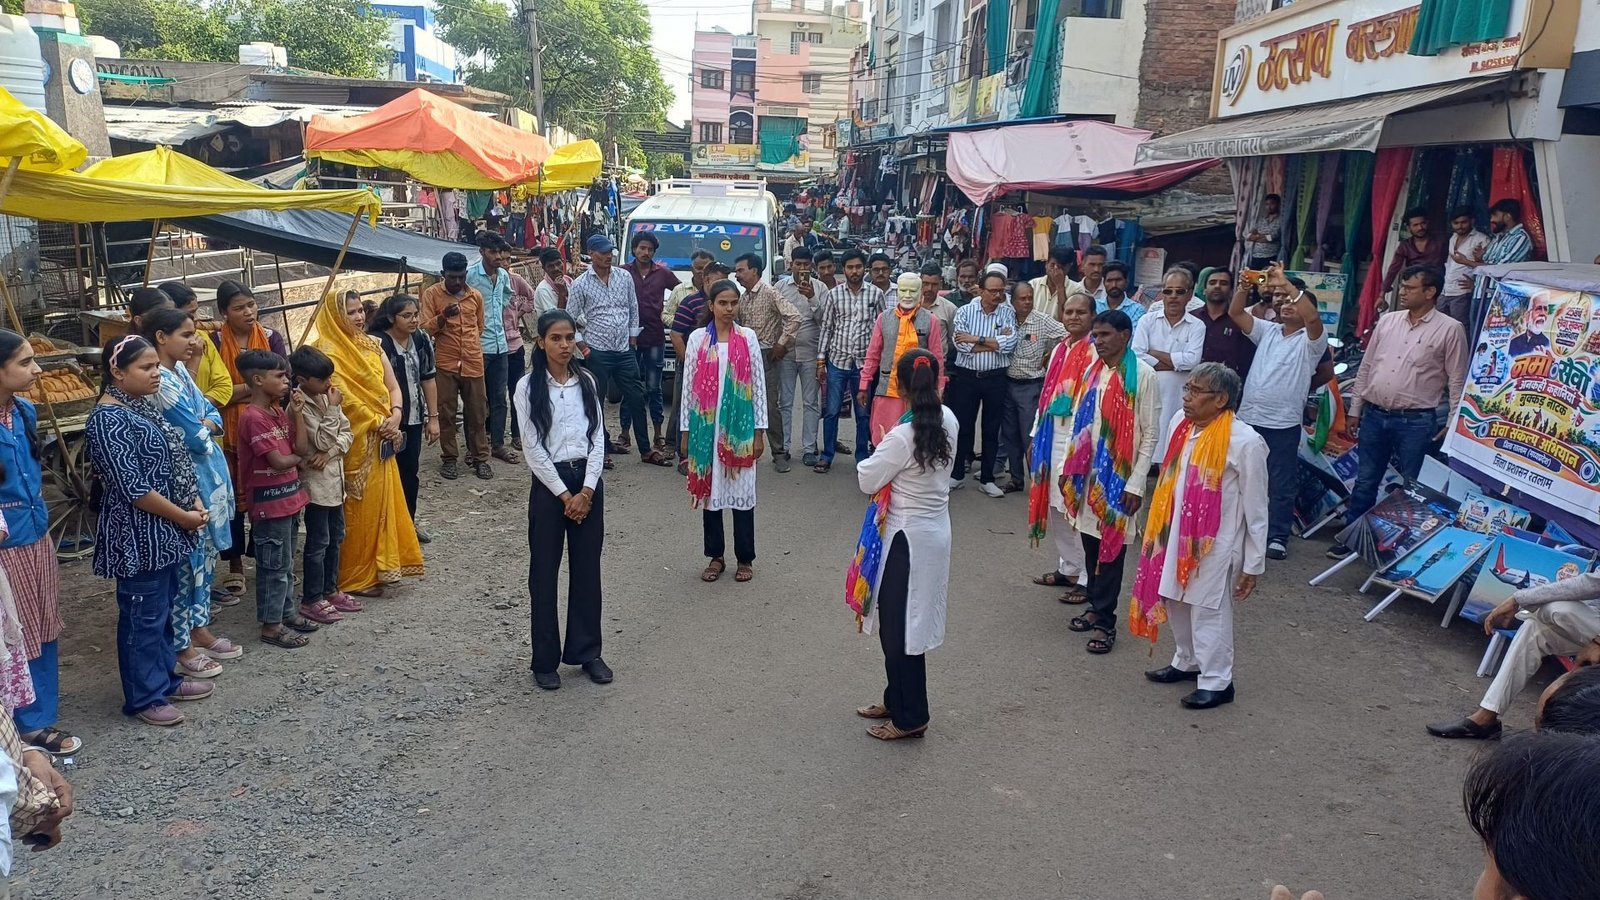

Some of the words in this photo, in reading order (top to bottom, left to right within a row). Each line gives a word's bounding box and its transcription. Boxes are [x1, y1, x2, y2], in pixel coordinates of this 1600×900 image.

[1257, 19, 1340, 91] उत्सव
[1346, 8, 1420, 62] वस्त्रा
[1192, 141, 1215, 158] उत्सव
[1217, 137, 1262, 156] वस्त्रालय
[635, 223, 727, 233] DEVDA
[1511, 351, 1554, 379] नमो
[1558, 357, 1592, 397] सेवा
[1519, 379, 1546, 393] अनकही
[1546, 398, 1568, 416] नाटक
[1490, 421, 1508, 437] सेवा
[1509, 425, 1540, 446] संकल्प
[1539, 437, 1580, 468] अभियान
[1493, 453, 1507, 469] जिला
[1506, 459, 1529, 480] प्रशासन
[1528, 470, 1554, 490] रतलाम
